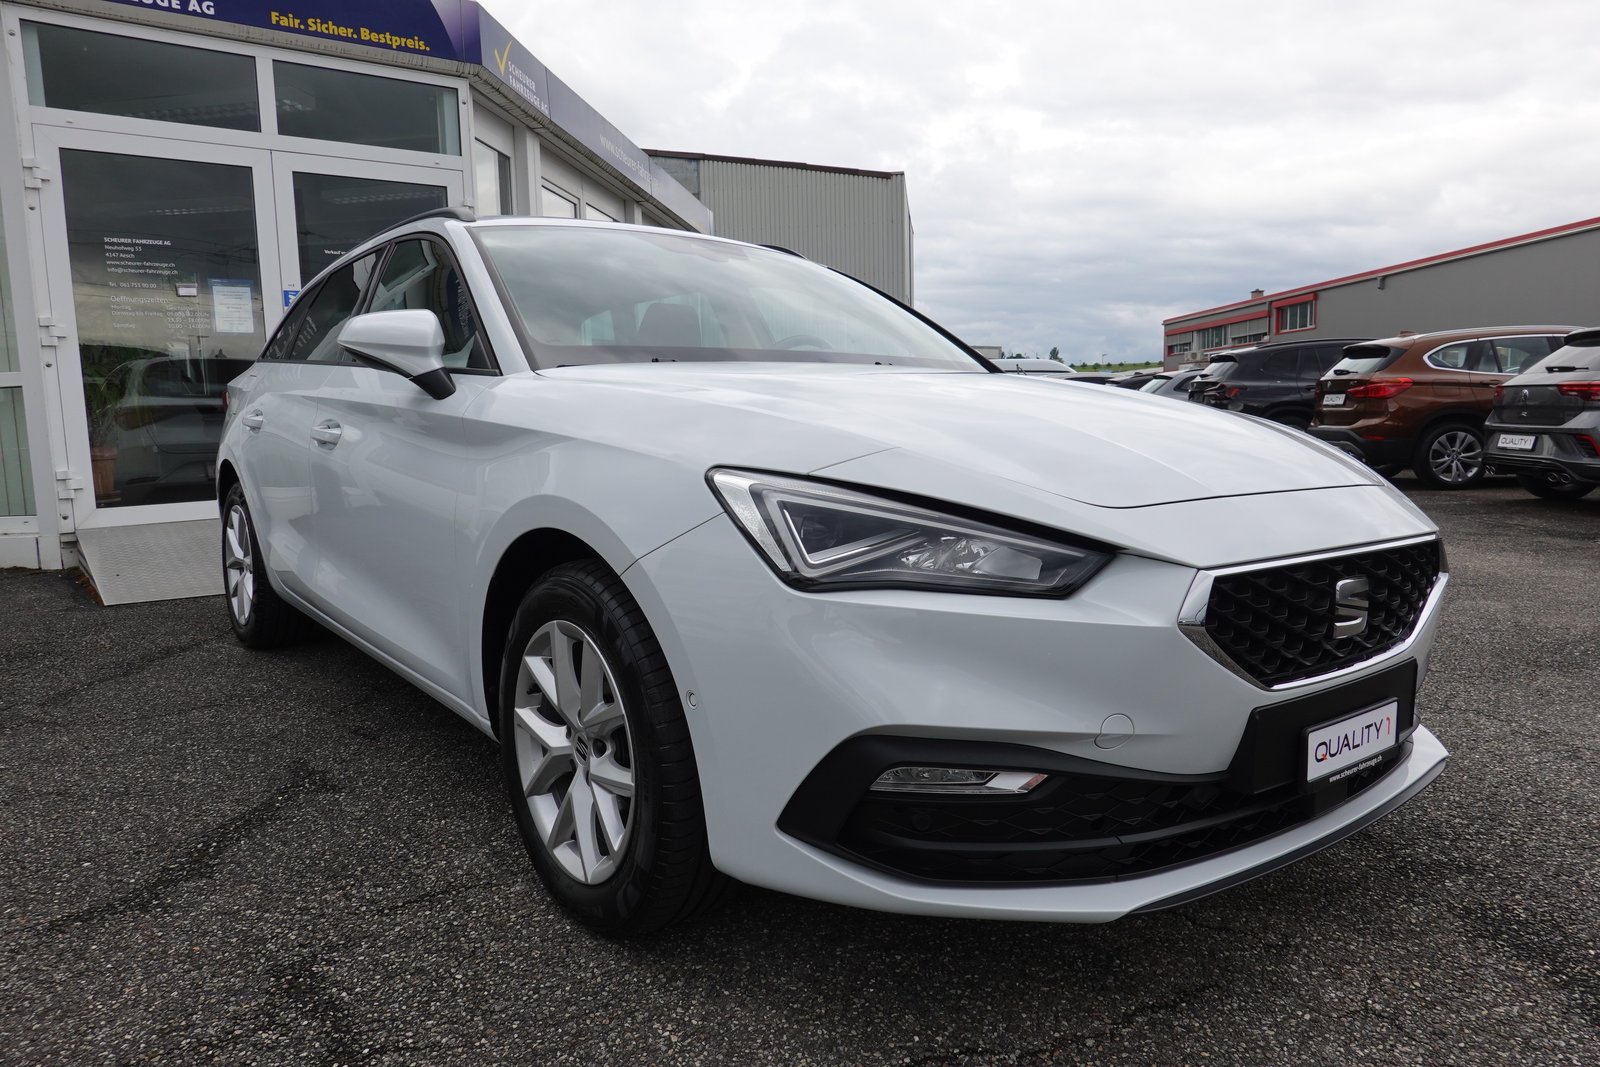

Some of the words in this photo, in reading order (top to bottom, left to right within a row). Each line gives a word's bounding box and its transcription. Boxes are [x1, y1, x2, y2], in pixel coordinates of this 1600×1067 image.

[188, 0, 215, 15] AG
[270, 11, 305, 30] Fair.
[307, 18, 358, 39] Sicher.
[360, 27, 431, 51] Bestpreis.
[508, 61, 536, 92] SCHEURER
[509, 74, 540, 109] FAHRZEUGE
[540, 100, 549, 114] AG
